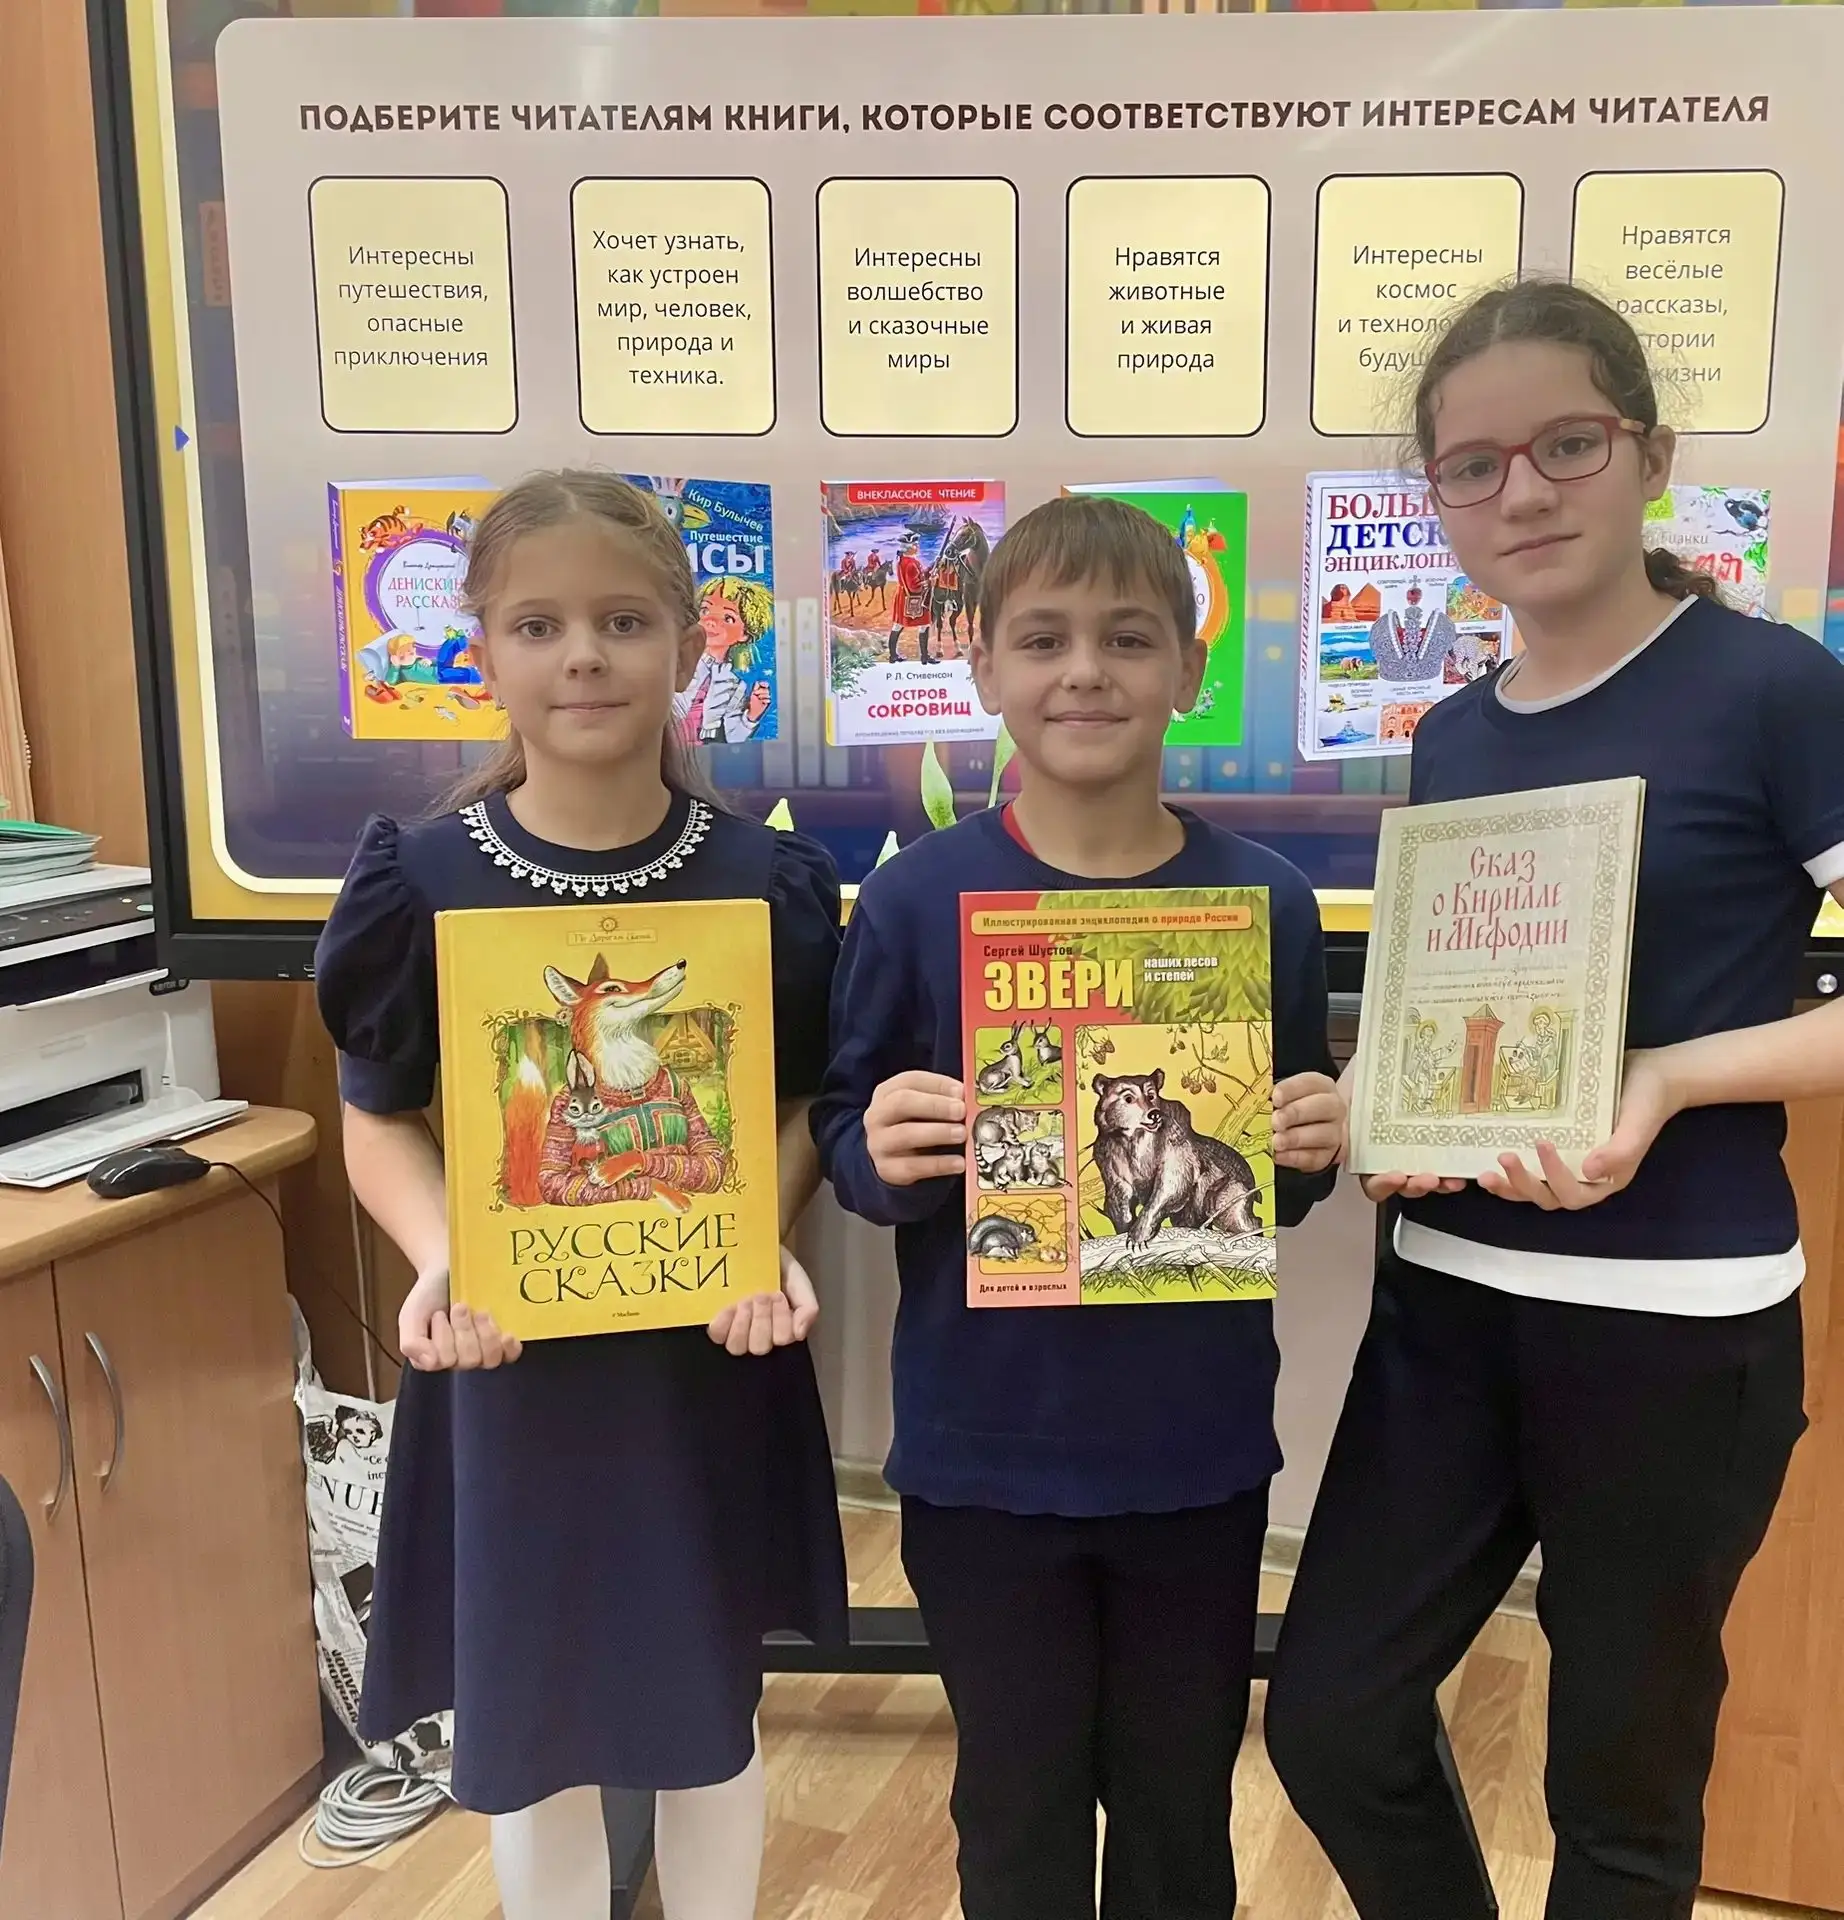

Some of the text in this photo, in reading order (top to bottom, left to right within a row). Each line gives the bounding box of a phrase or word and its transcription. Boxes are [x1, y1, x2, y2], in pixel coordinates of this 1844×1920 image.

[299, 95, 1770, 134] ПОДБЕРИТЕ ЧИТАТЕЛЯМ КНИГИ, КОТОРЫЕ СООТВЕТСТВУЮТ ИНТЕРЕСАМ ЧИТАТЕЛЯ
[592, 229, 745, 256] Хочет узнать,
[1622, 225, 1731, 250] Нравятся
[347, 246, 475, 271] Интересны
[854, 247, 982, 271] Интересны
[1114, 247, 1221, 271] Нравятся
[1353, 245, 1483, 270] Интересны
[607, 267, 740, 291] как устроен
[1625, 260, 1724, 280] весёлые
[338, 280, 490, 304] путешествия,
[847, 282, 985, 302] волшебство
[1108, 283, 1225, 301] животные
[1376, 284, 1457, 299] космос
[596, 301, 752, 325] мир, человек,
[1616, 299, 1728, 316] рассказы,
[366, 314, 465, 334] опасные
[848, 317, 990, 336] и сказочные
[1120, 318, 1213, 336] и живая
[1337, 319, 1352, 333] и
[616, 333, 734, 358] природа и
[334, 346, 489, 369] приключения
[887, 351, 950, 374] миры
[1116, 351, 1216, 373] природа
[628, 366, 725, 386] техника.
[857, 488, 976, 500] ВНЕКЛАССНОЕ ЧТЕНИЕ
[688, 488, 764, 532] Кир Булычев
[690, 530, 763, 543] Путешествие
[906, 672, 953, 680] Стивенсон
[892, 688, 948, 701] ОСТРОВ
[867, 701, 972, 718] СОКРОВИЩ
[1470, 846, 1536, 884] Сказ
[1432, 881, 1565, 925] о Кирилле
[983, 912, 1239, 928] Иллюстрированная энциклопедия о природе России
[1427, 928, 1442, 952] и
[983, 944, 1073, 959] Сергей Шустов
[1144, 956, 1218, 969] наших лесов
[983, 958, 1135, 1011] ЗВЕРИ
[1144, 969, 1195, 983] и степей
[510, 1213, 738, 1266] РУССКИЕ
[518, 1252, 729, 1304] СКАЗКИ
[979, 1283, 995, 1293] Для
[997, 1283, 1019, 1293] детей
[1029, 1283, 1067, 1292] взрослых
